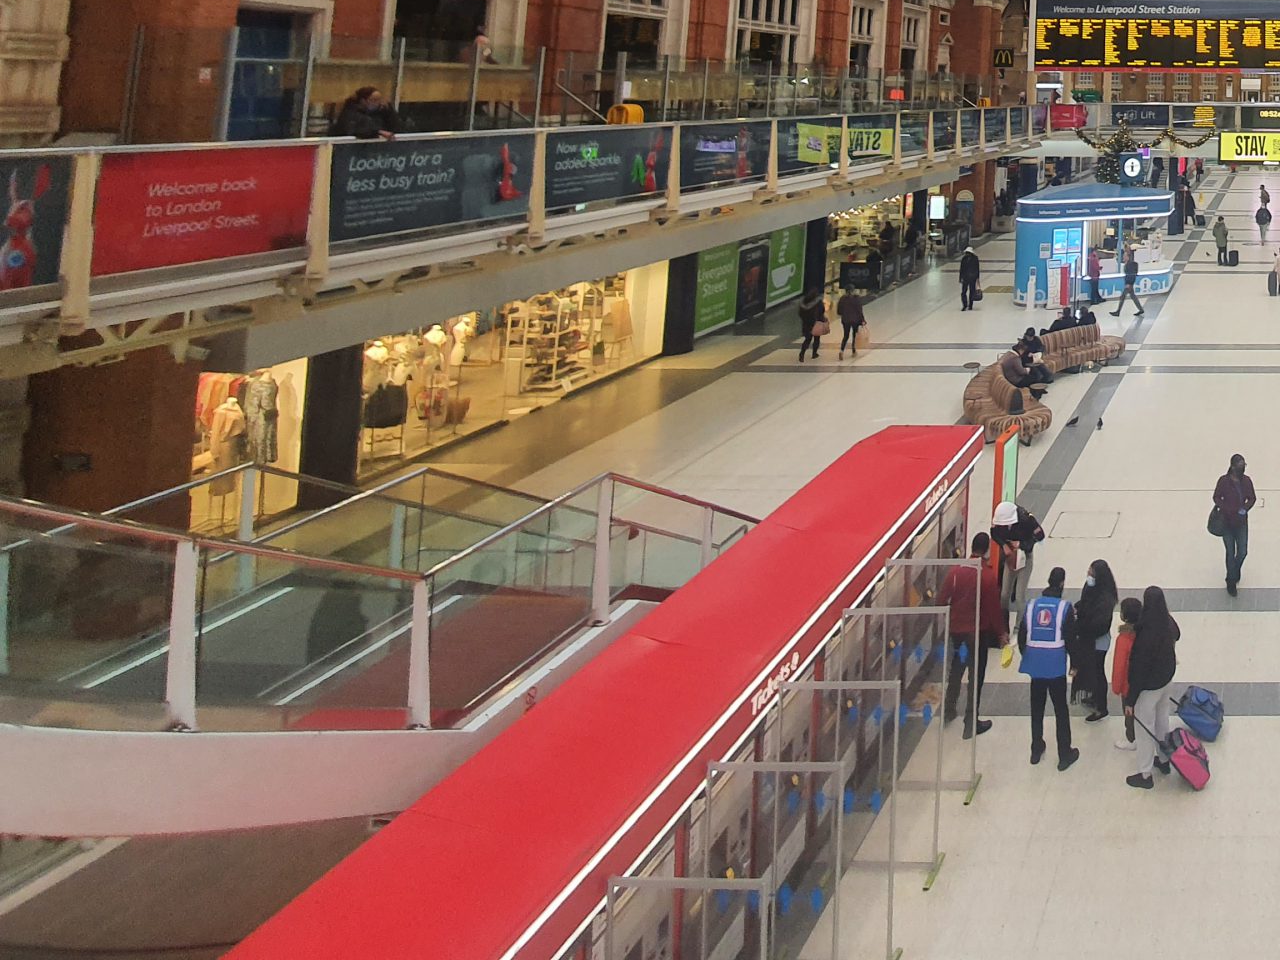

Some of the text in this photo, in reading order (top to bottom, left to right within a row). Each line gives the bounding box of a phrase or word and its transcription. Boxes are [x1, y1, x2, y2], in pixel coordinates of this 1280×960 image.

[1054, 5, 1085, 13] Welcome
[1096, 4, 1137, 16] Liverpool
[1138, 4, 1166, 14] Street
[1167, 5, 1200, 14] Station
[1141, 111, 1155, 119] Lift
[556, 142, 577, 154] Now
[1235, 135, 1267, 156] STAY.
[349, 152, 442, 171] Looking for a
[555, 156, 586, 171] added
[149, 177, 257, 197] Welcome back
[347, 168, 455, 192] less busy train?
[145, 199, 222, 217] to London
[142, 217, 212, 237] Liverpool
